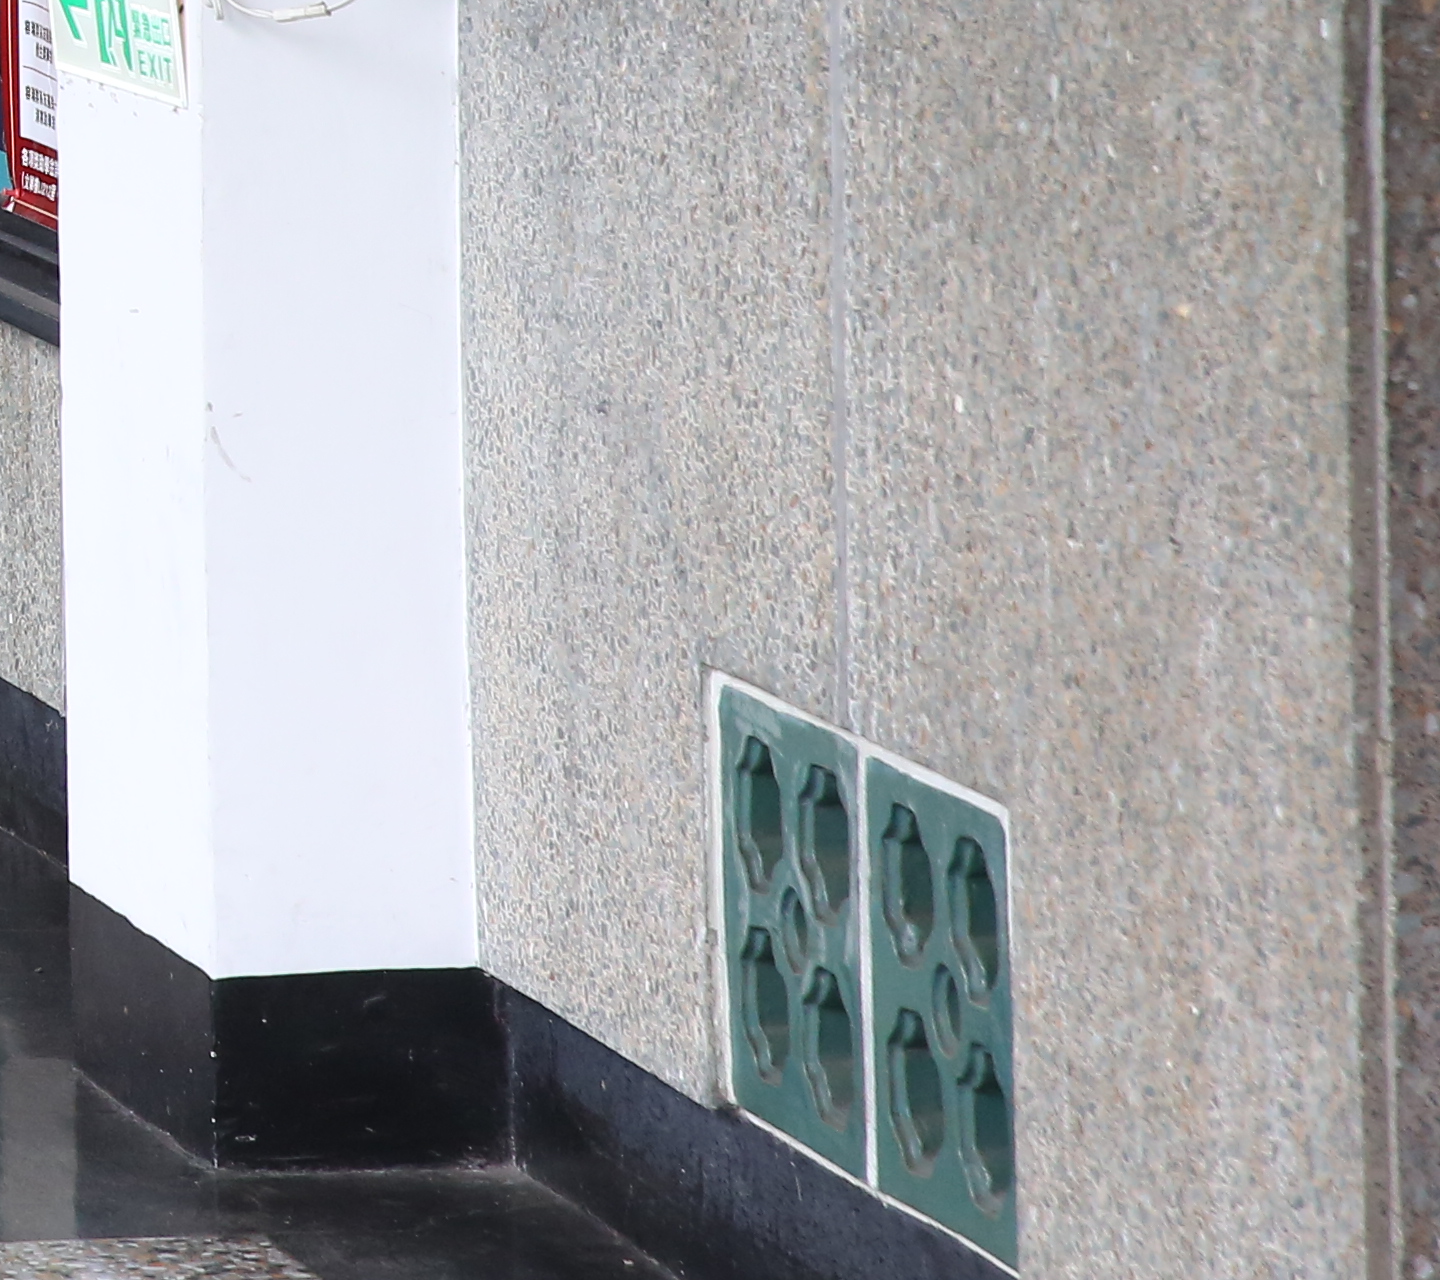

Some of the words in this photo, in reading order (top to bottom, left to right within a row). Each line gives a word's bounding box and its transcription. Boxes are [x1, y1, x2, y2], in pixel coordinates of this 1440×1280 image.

[131, 8, 172, 47] 緊急出口
[138, 50, 173, 85] EXIT
